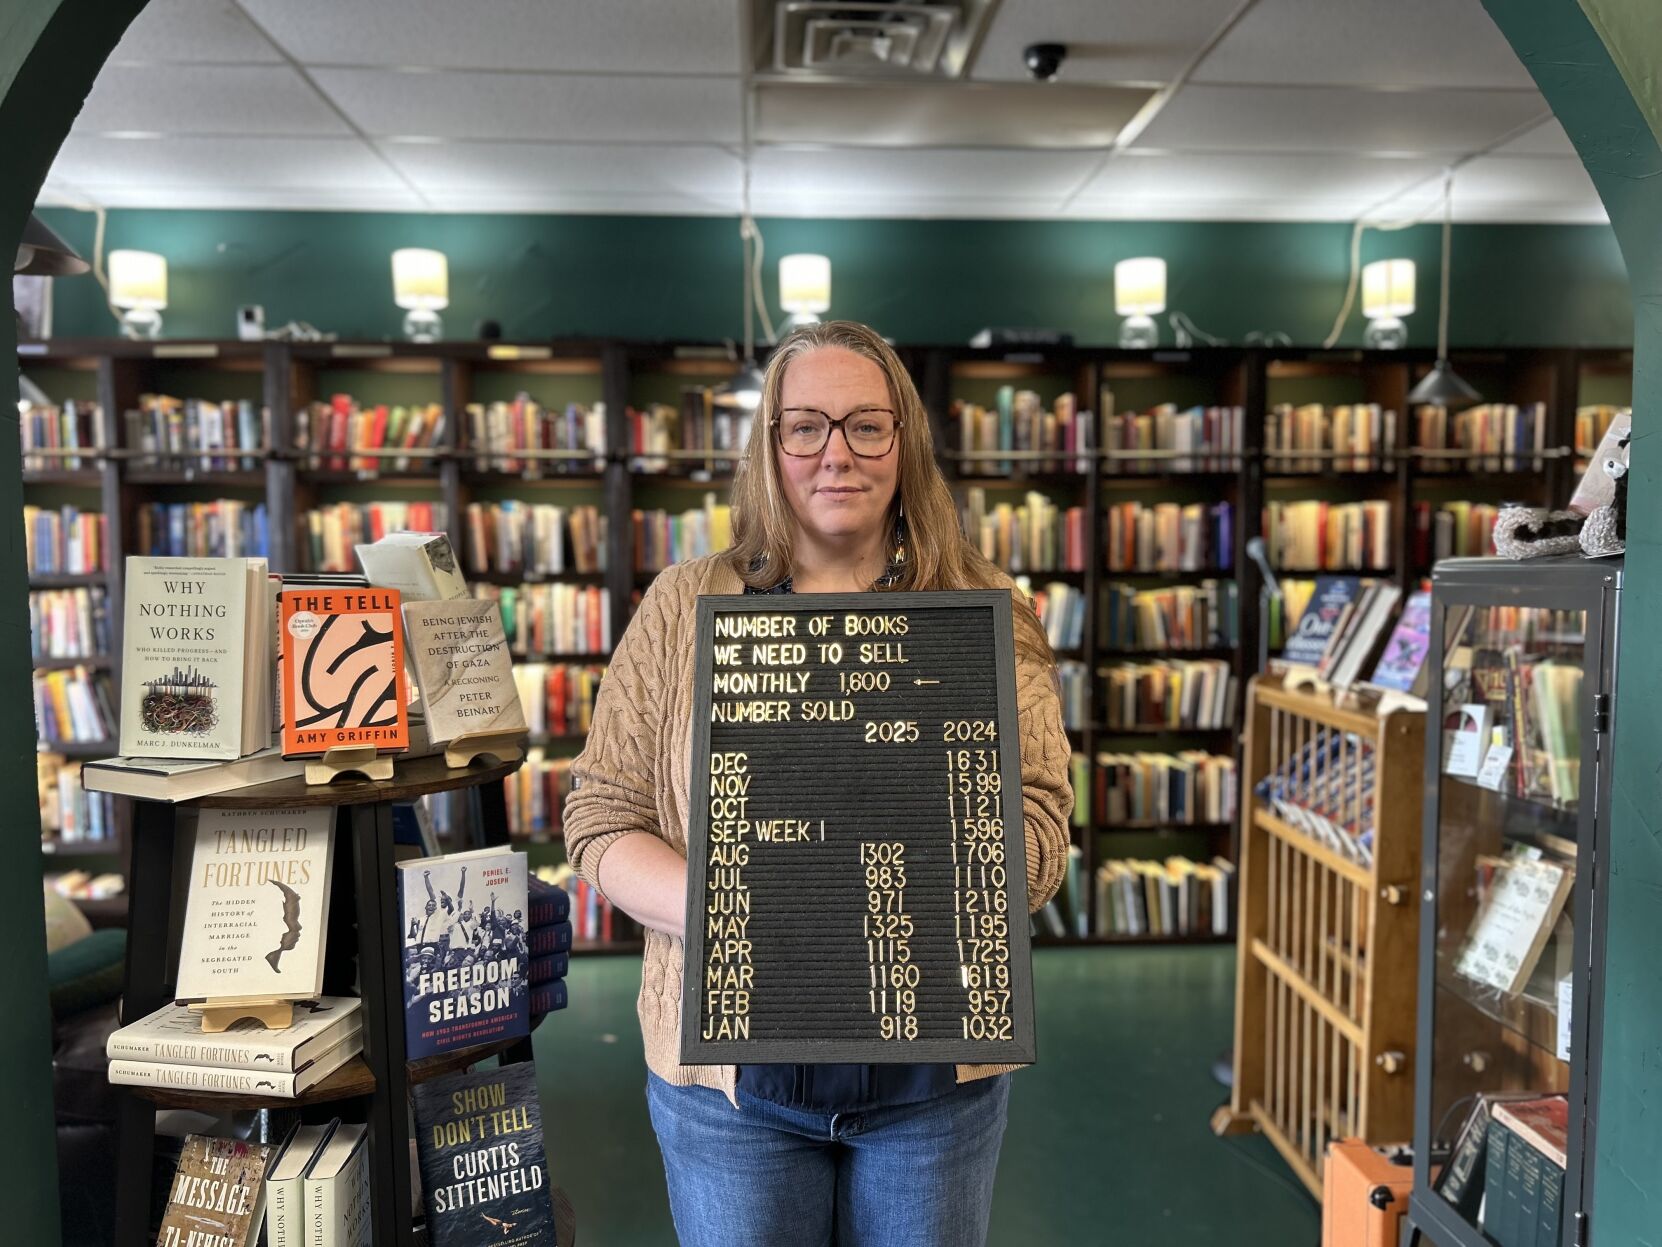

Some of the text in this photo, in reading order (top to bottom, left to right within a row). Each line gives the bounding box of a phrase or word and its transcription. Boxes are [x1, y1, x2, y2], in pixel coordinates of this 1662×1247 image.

[164, 581, 206, 594] WHY
[140, 603, 226, 618] NOTHING
[293, 595, 394, 611] THE TELL
[150, 626, 215, 640] WORKS
[422, 615, 492, 627] BEING JEWISH
[715, 615, 909, 637] NUMBER OF BOOKS
[434, 630, 489, 641] AFTER THE
[428, 643, 501, 656] DESTRUCTION
[714, 643, 909, 666] WE NEED TO SELL
[446, 659, 491, 670] OF GAZA
[452, 675, 500, 686] RECKONING
[714, 671, 891, 696] MONTHLY 1,600
[459, 691, 492, 702] PETER
[457, 705, 501, 718] BEINART
[711, 700, 855, 723] NUMBER SOLD
[296, 730, 398, 744] AMY GRIFFIN
[865, 720, 997, 743] 2025 2024
[161, 740, 169, 748] J.
[170, 741, 220, 749] DUNKELMAN
[711, 750, 998, 775] DEC 1631
[711, 773, 1001, 797] NOV 1599
[711, 795, 1000, 820] OCT 1121
[214, 827, 308, 854] TANGLED
[711, 819, 750, 843] SEP
[755, 820, 811, 843] WEEK
[951, 818, 1003, 841] 1596
[709, 841, 1004, 866] AUG 1302 1706
[203, 859, 311, 888] FORTUNES
[486, 877, 509, 887] JOSEPH
[709, 865, 1006, 890] JUL 983 1110
[708, 889, 1007, 915] JUN 971 1216
[708, 914, 1007, 939] MAY 1325 1195
[201, 955, 253, 963] SEGREGATED
[709, 940, 1009, 964] APR 1115 1725
[419, 956, 518, 997] FREEDOM
[707, 964, 1009, 989] MAR 1160 1619
[429, 986, 510, 1023] SEASON
[708, 990, 1011, 1015] FEB 1119 957
[703, 1015, 1012, 1040] JAN 918 1032
[113, 1043, 250, 1065] SCHUMAKER TANGLED FORTUNES
[115, 1068, 251, 1091] SCHUMAKER TANGLED FORTUNES
[452, 1082, 506, 1115] SHOW
[433, 1106, 533, 1149] DON'T TELL
[210, 1156, 229, 1176] THE
[453, 1142, 520, 1180] CURTIS
[173, 1175, 250, 1215] MESSAGE
[276, 1187, 285, 1211] WHY
[314, 1185, 323, 1209] WHY
[434, 1165, 543, 1214] SITTENFELD
